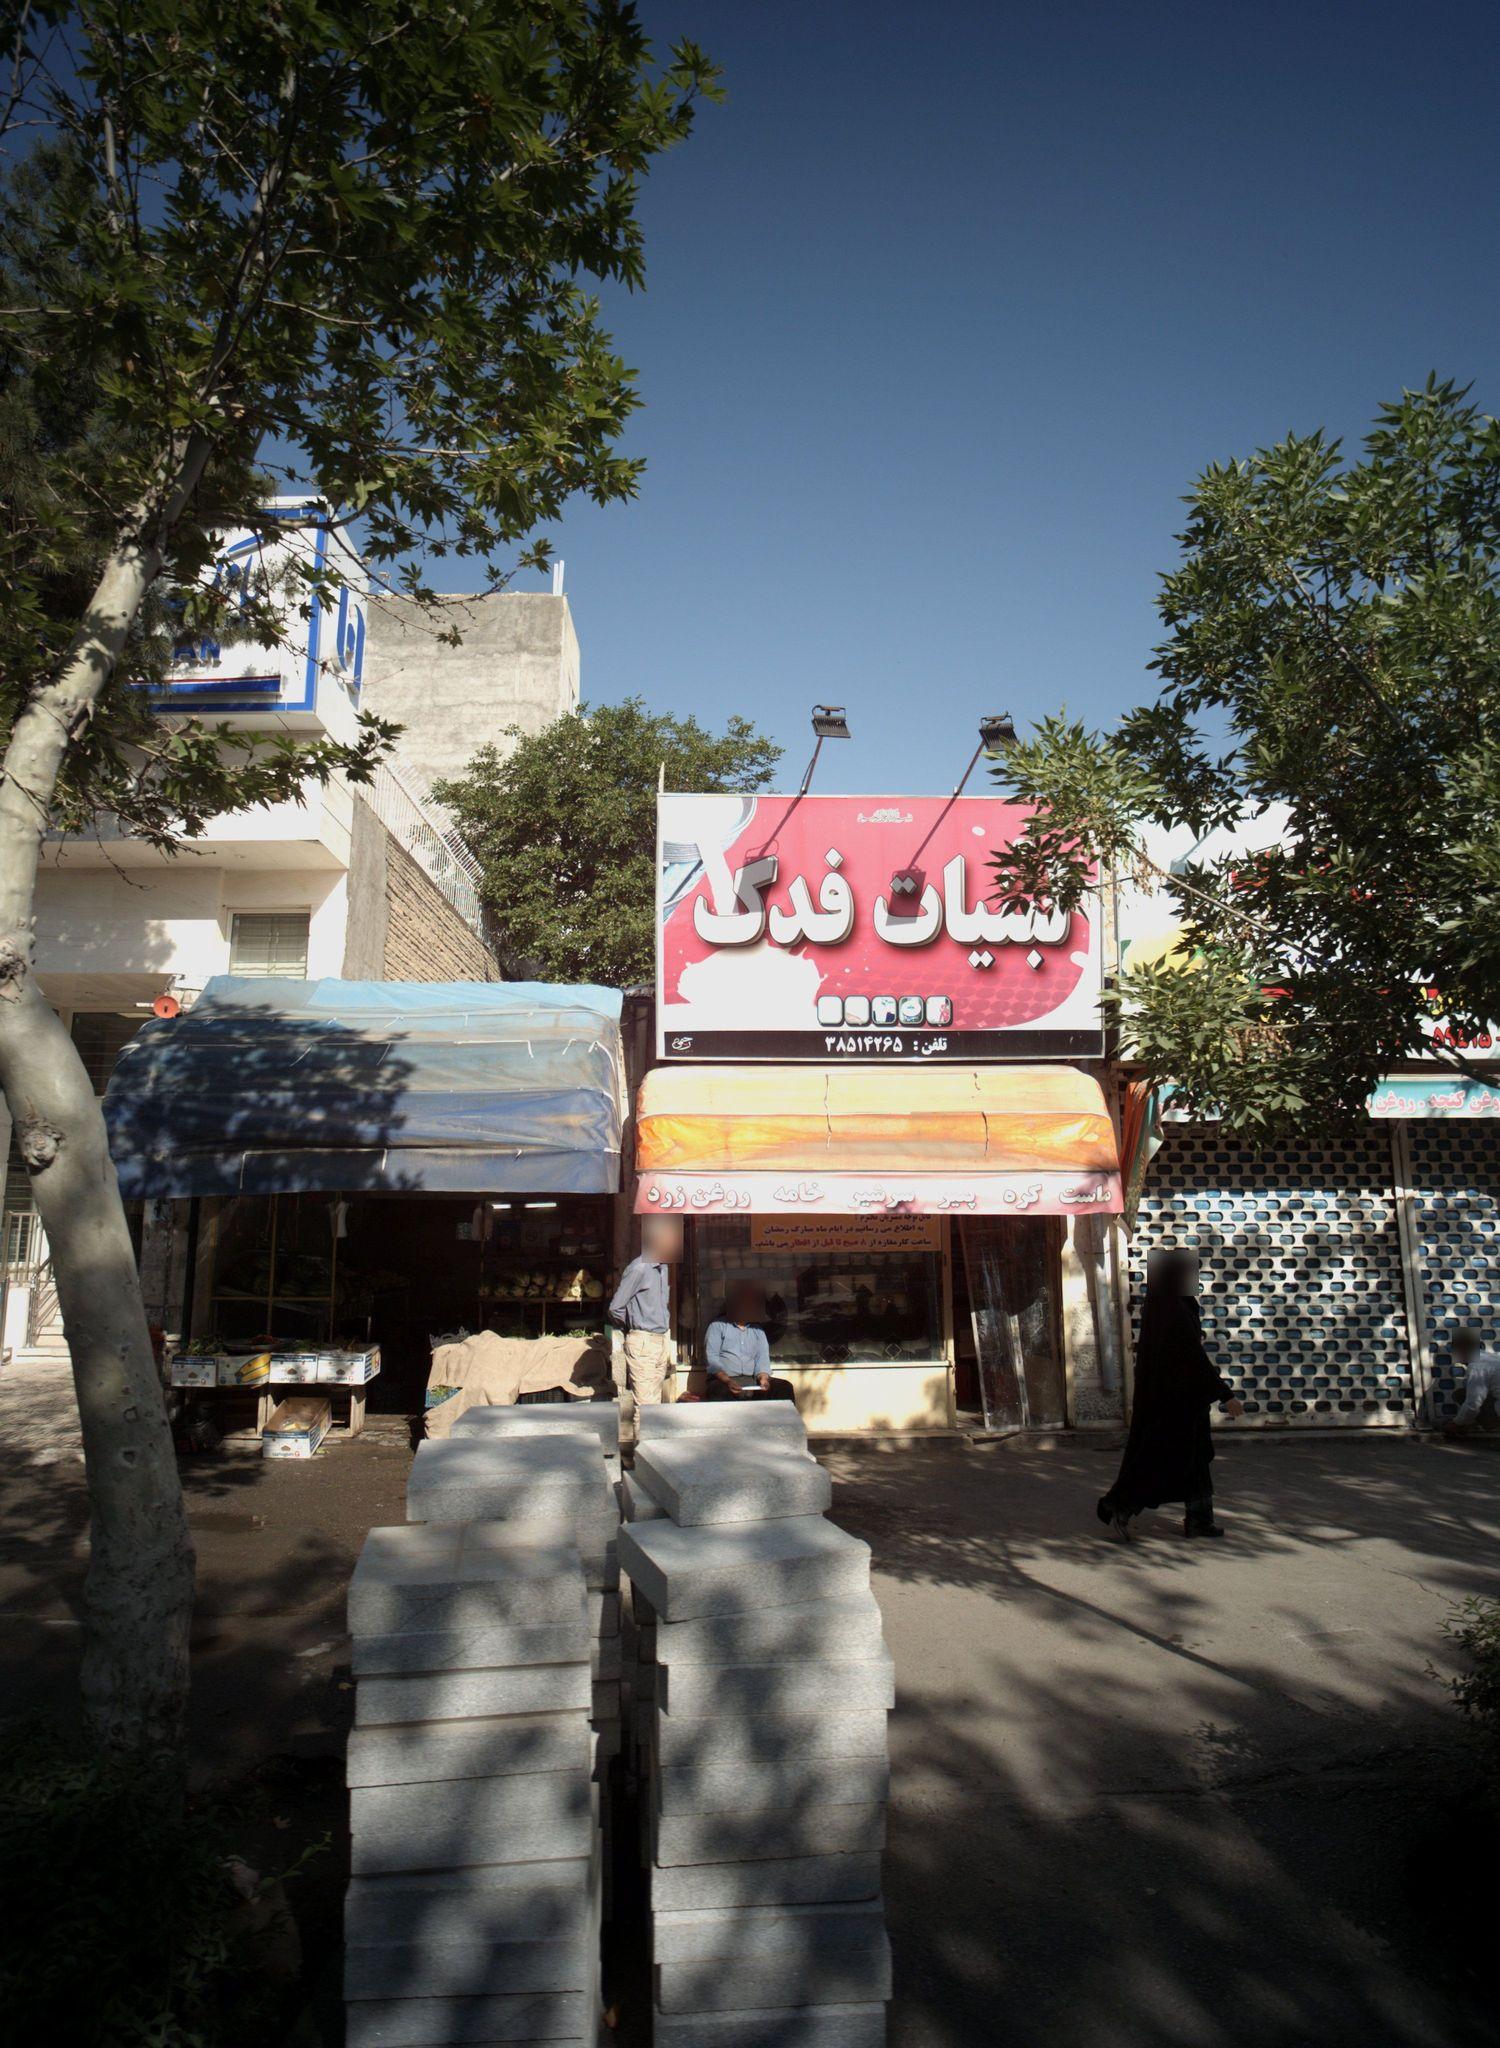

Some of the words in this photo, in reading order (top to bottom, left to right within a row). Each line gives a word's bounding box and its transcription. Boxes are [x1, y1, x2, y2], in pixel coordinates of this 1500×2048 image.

[693, 847, 854, 946] فدک
[824, 1036, 903, 1053] ۳۸۵۱۴۲۶۵
[1375, 1089, 1416, 1113] روغن
[1427, 1089, 1466, 1112] کنجد
[647, 1186, 687, 1209] زرد
[691, 1182, 752, 1209] روغن
[774, 1182, 825, 1203] خامه
[938, 1189, 977, 1209] پنیر
[1003, 1184, 1042, 1209] کره
[1059, 1184, 1112, 1205] ماست
[764, 1225, 789, 1235] رمضان
[816, 1225, 828, 1233] ماه
[894, 1224, 915, 1234] اطلاع
[911, 1238, 932, 1246] ساعت
